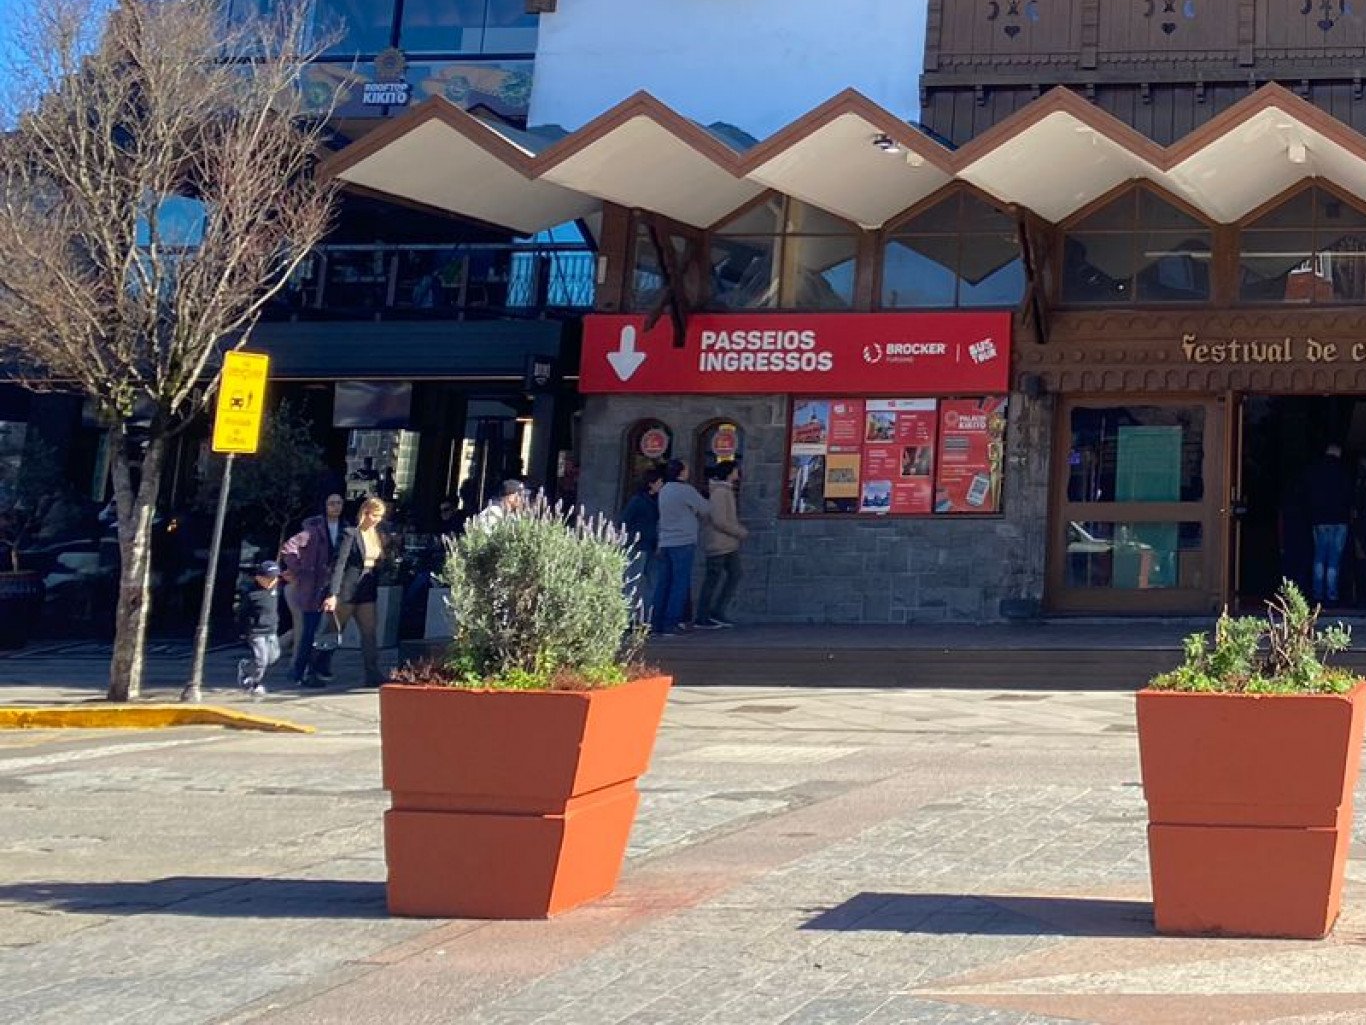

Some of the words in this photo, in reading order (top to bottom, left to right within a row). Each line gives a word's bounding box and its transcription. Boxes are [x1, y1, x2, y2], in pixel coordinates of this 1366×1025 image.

[700, 329, 816, 350] PASSEIOS
[885, 342, 946, 355] BROCKER
[1306, 337, 1339, 363] de
[699, 351, 834, 372] INGRESSOS
